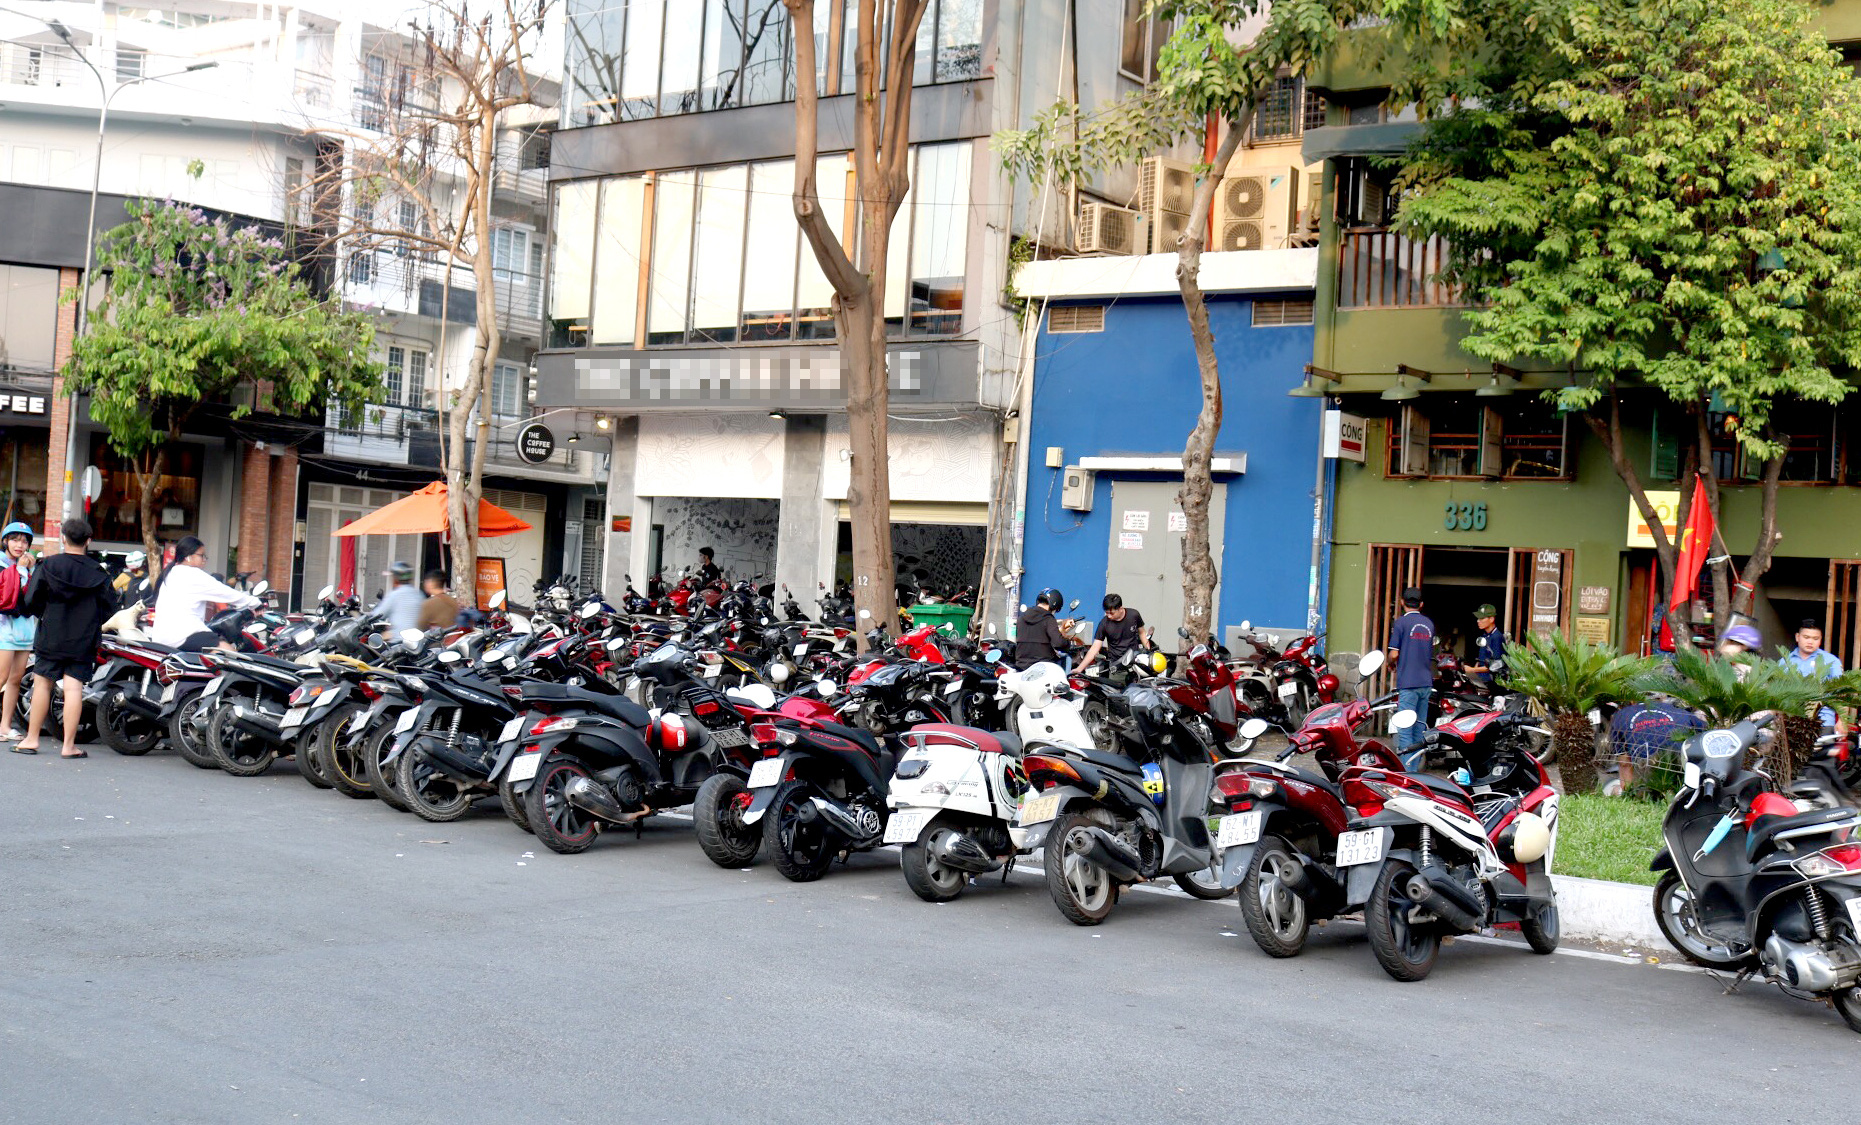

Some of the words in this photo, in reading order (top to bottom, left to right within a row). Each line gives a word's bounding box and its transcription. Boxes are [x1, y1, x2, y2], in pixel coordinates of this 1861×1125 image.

[527, 431, 540, 439] THE
[526, 439, 551, 448] COFFEE
[525, 447, 547, 456] HOUSE
[1443, 500, 1488, 531] 336
[1537, 549, 1560, 565] CỘNG
[858, 575, 869, 586] 12
[1190, 605, 1203, 616] 14
[1344, 831, 1375, 849] 59-G1
